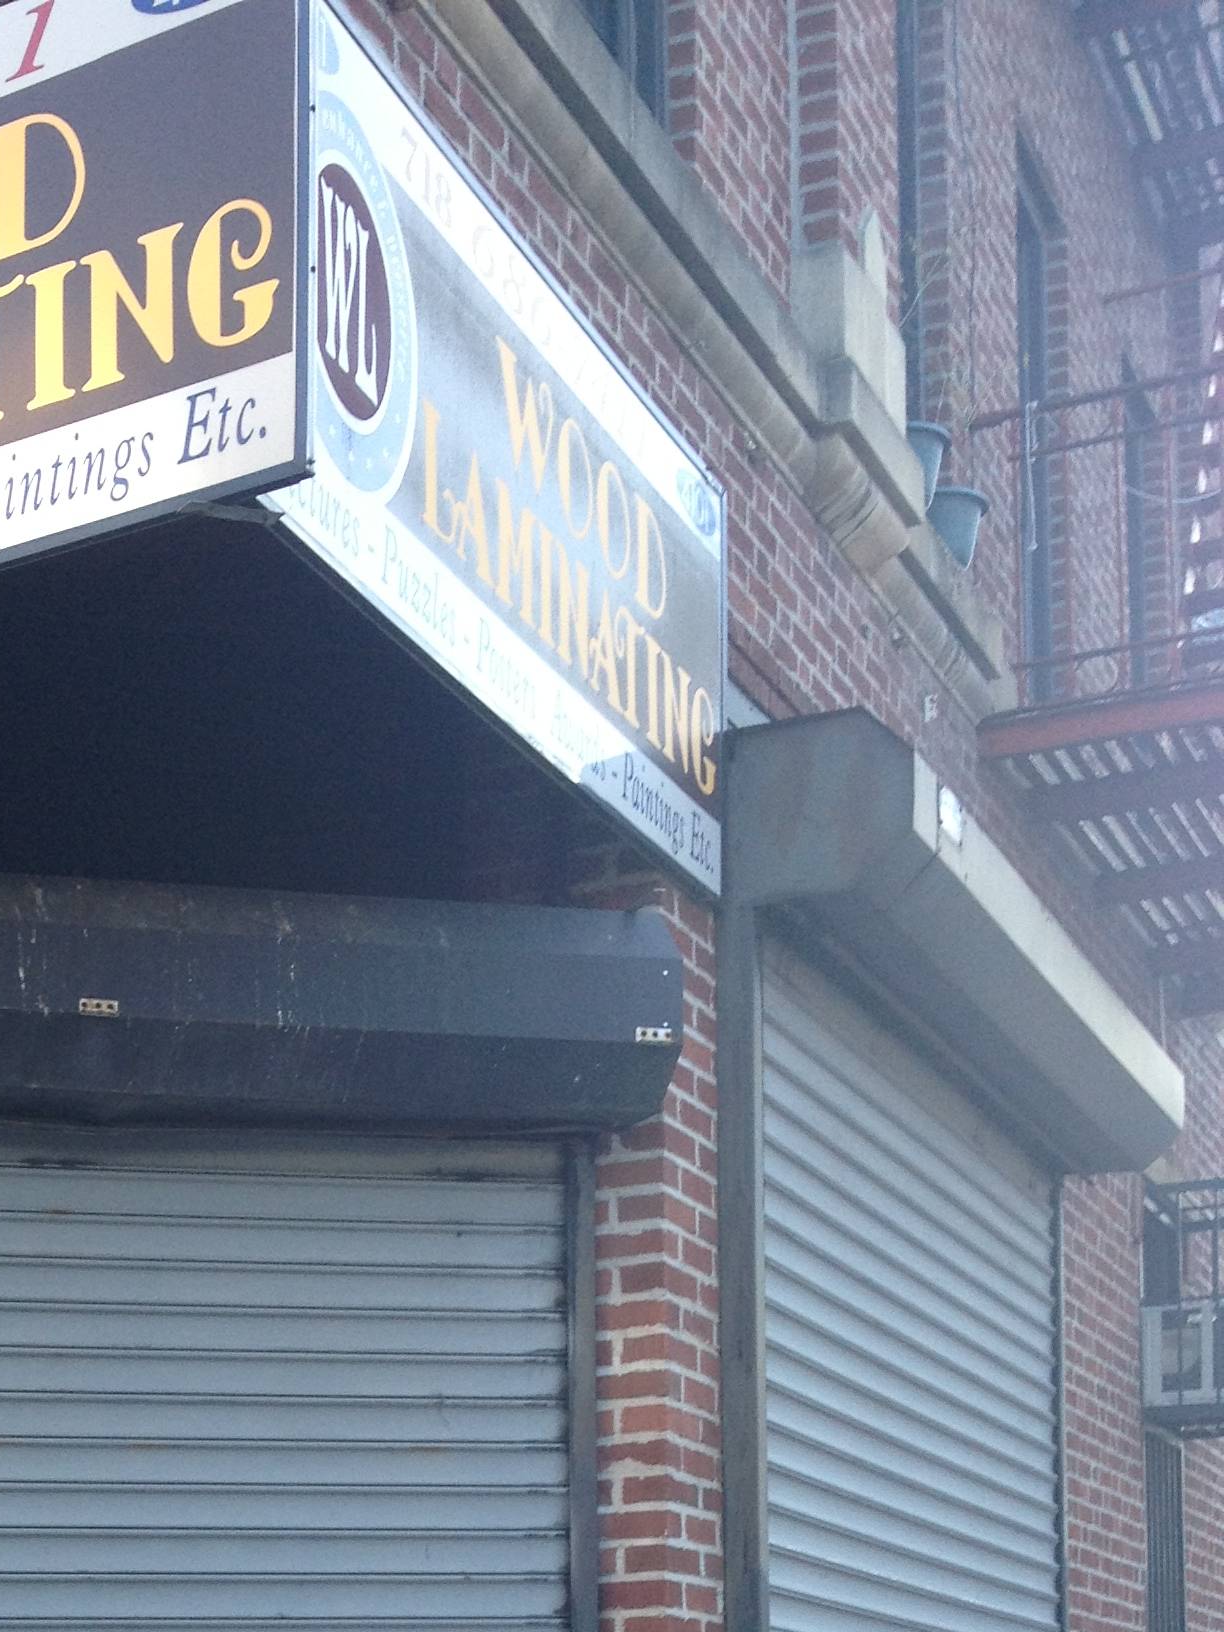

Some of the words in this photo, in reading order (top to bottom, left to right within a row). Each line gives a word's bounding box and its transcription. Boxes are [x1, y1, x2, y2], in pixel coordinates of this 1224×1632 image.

[177, 387, 267, 466] Etc.
[495, 334, 668, 620] WOOD
[420, 398, 717, 796] LAMINATING
